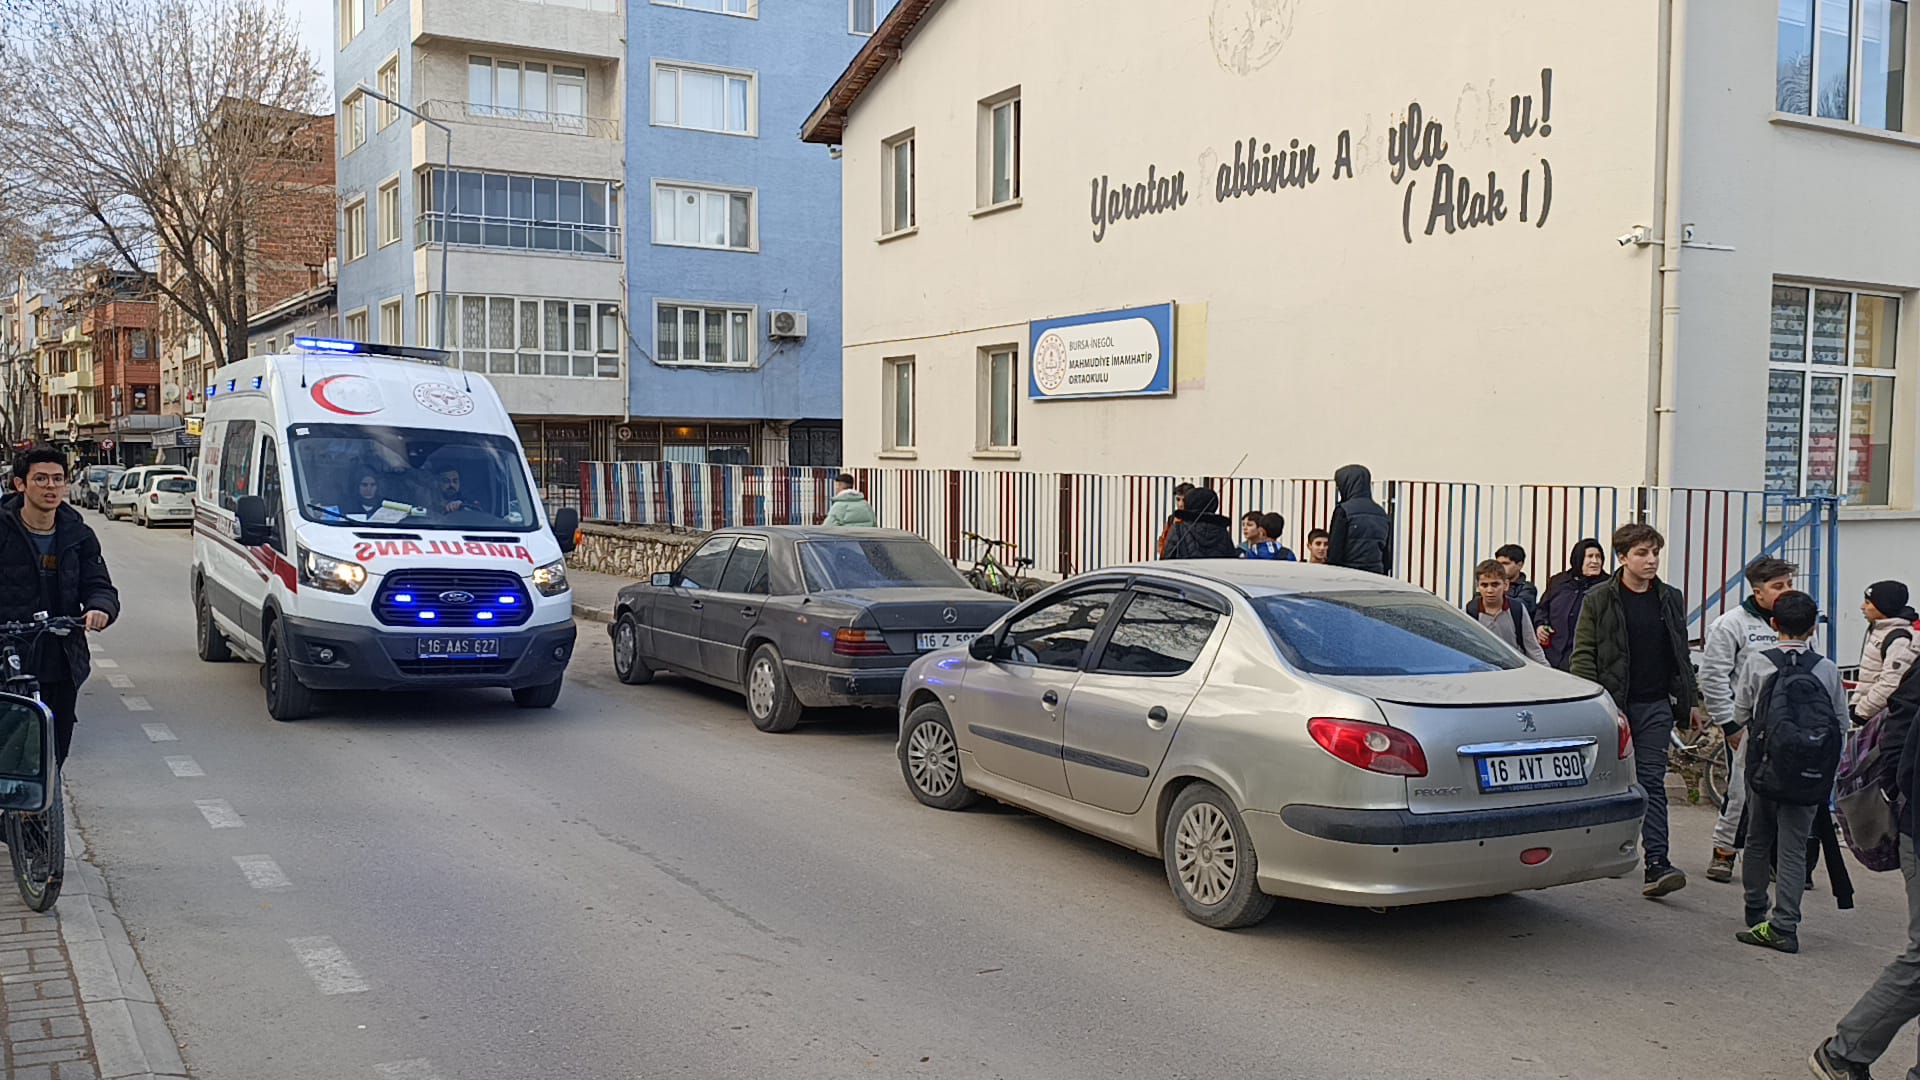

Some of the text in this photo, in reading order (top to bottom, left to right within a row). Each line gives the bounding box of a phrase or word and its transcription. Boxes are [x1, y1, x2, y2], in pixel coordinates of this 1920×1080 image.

[1091, 165, 1188, 243] Yaratan
[1069, 351, 1152, 368] MAHMUDİYE İMAMHATİP
[1068, 373, 1109, 384] ORTAOKULU
[428, 640, 496, 653] 16 AAS 627
[924, 634, 936, 648] 16
[942, 634, 950, 648] Z
[1490, 760, 1509, 783] 16
[1519, 757, 1544, 781] AVT
[1553, 754, 1580, 778] 690
